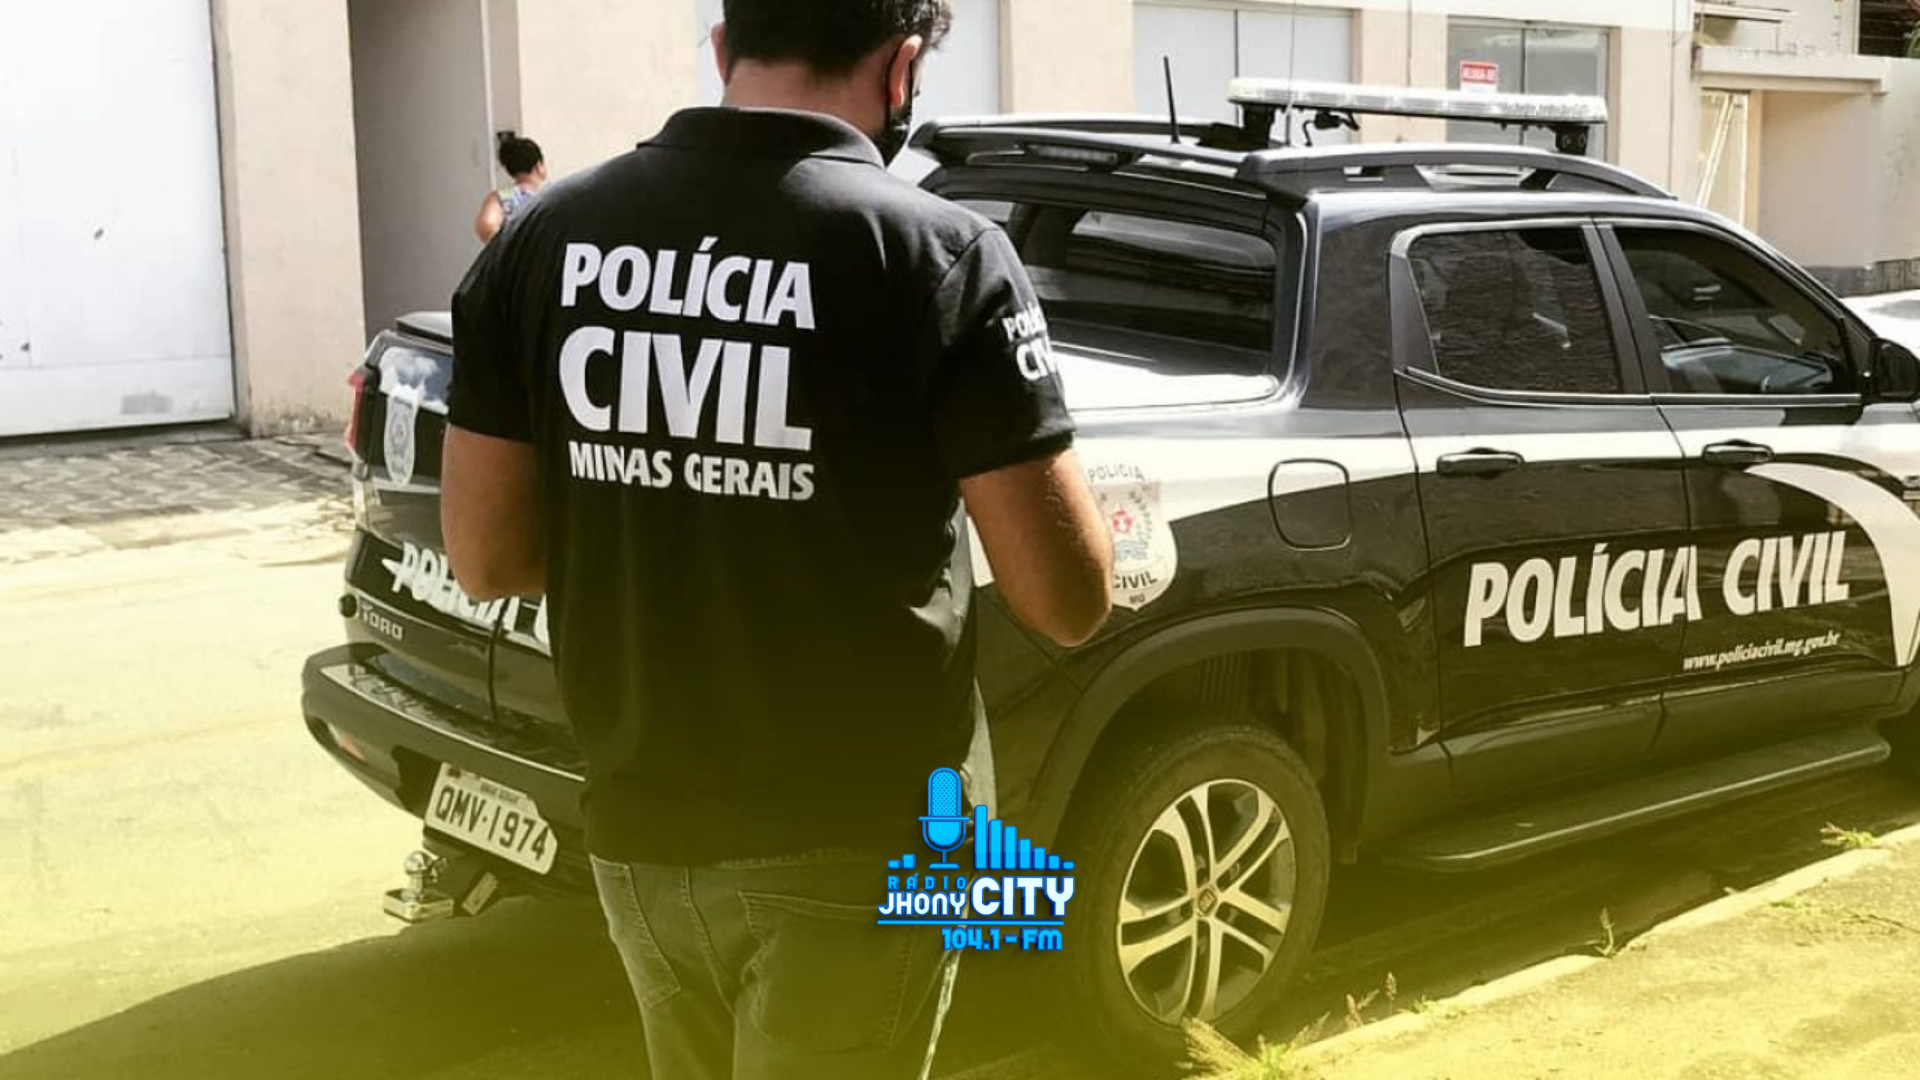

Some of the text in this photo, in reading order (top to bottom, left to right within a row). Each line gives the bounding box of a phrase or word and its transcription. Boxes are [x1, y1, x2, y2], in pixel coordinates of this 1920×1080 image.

[561, 236, 815, 330] POLÍCIA
[558, 325, 812, 451] CIVIL
[569, 440, 815, 501] MINAS GERAIS
[361, 604, 403, 641] TORO
[1464, 531, 1849, 647] POLÍCIA CIVIL
